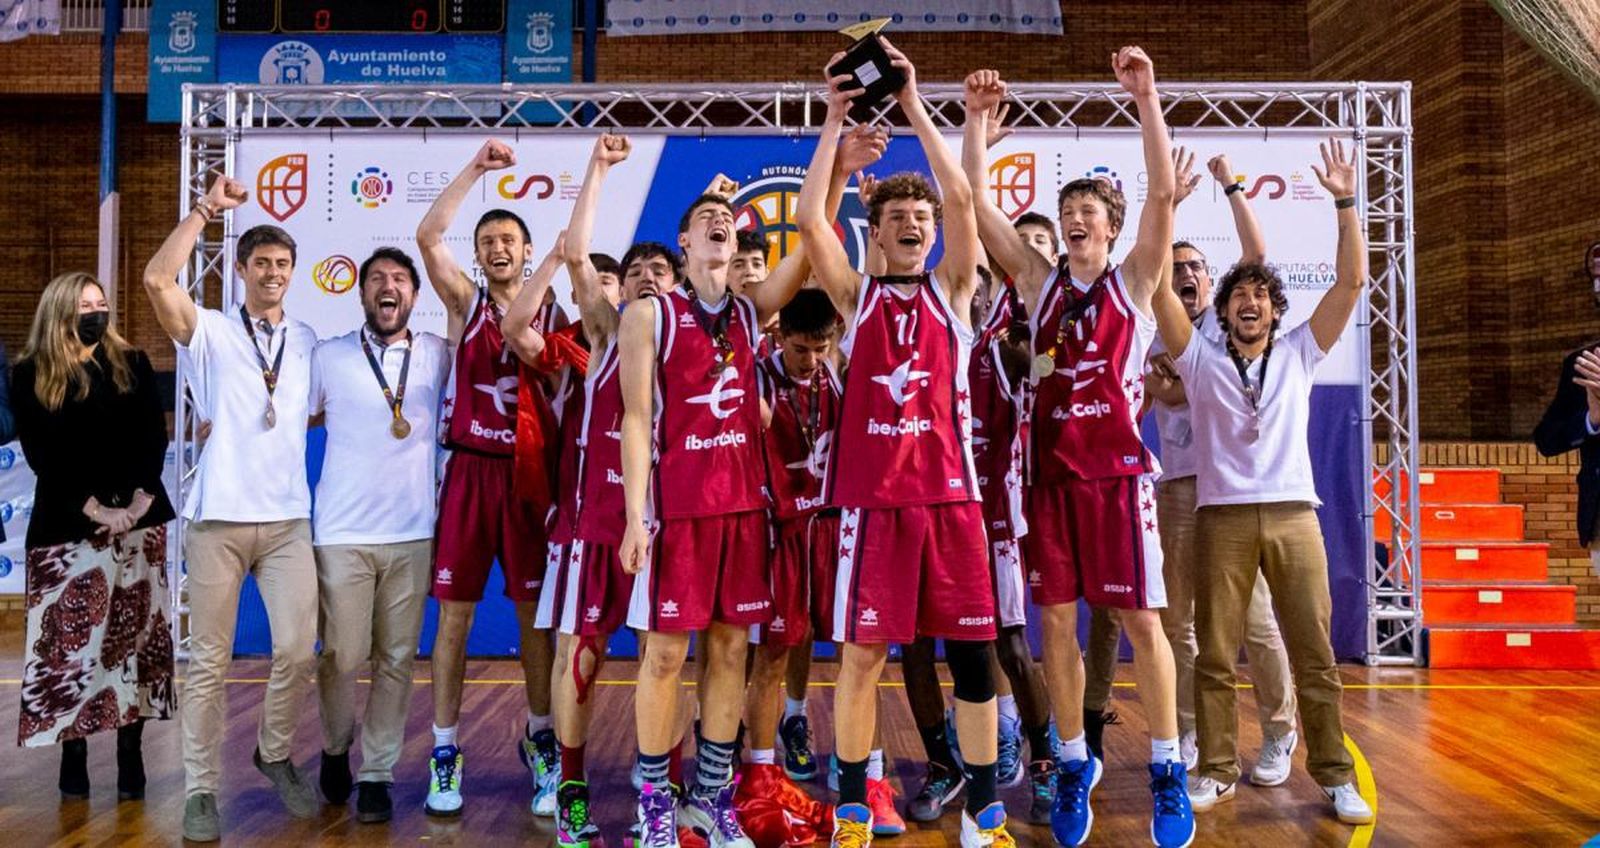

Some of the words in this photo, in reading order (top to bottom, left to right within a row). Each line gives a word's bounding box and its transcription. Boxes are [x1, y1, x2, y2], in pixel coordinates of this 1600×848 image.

[314, 10, 330, 30] 0
[412, 9, 428, 30] 0
[328, 49, 446, 64] Ayuntamiento
[361, 64, 382, 76] de
[387, 64, 446, 76] Huelva
[407, 171, 449, 185] CES
[1288, 273, 1336, 284] HUELVA
[868, 416, 931, 437] iberCaja
